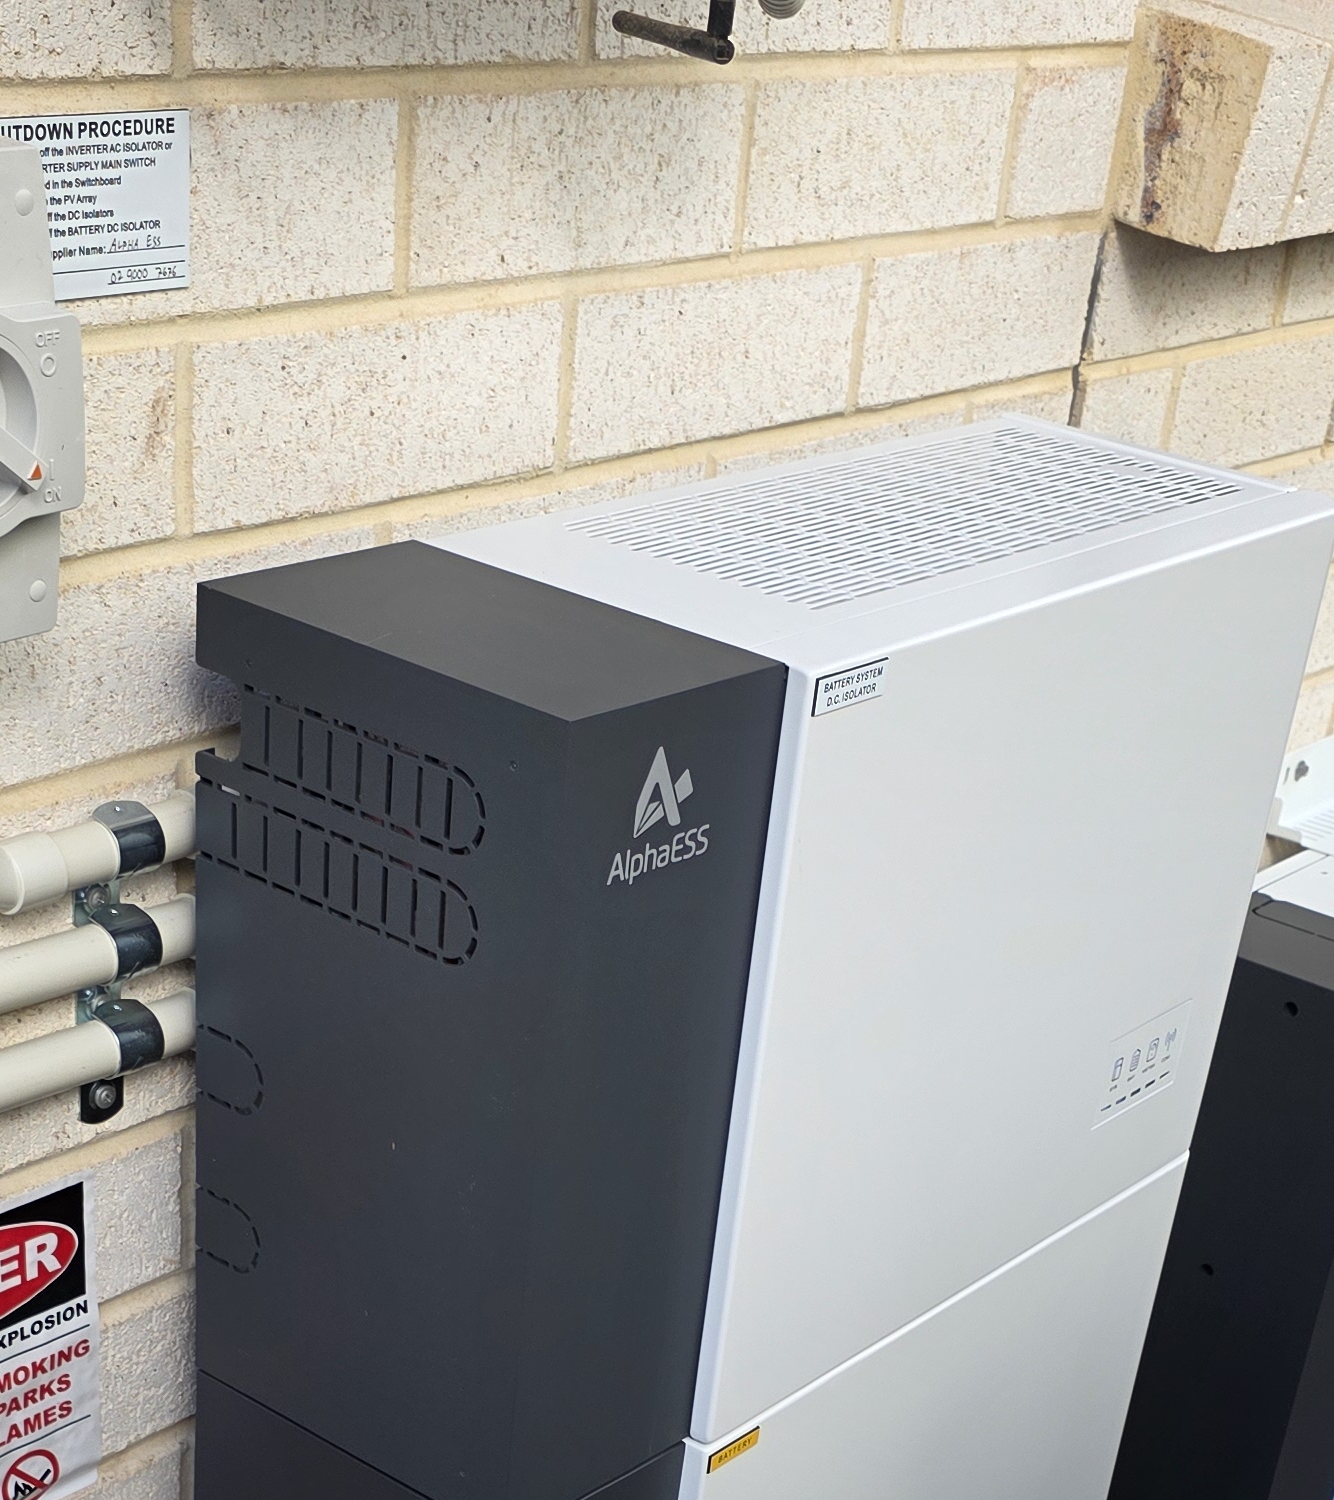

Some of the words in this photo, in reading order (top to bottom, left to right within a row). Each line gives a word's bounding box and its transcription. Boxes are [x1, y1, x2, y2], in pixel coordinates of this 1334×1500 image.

[78, 117, 175, 139] PROCEDURE
[51, 147, 64, 157] the
[66, 144, 108, 156] INVERTER
[109, 142, 122, 154] AC
[123, 141, 164, 153] ISOLATOR
[164, 142, 173, 150] or
[42, 162, 65, 173] RTER
[67, 160, 100, 172] SUPPLY
[101, 159, 122, 170] MAIN
[123, 157, 156, 168] SWITCH
[61, 179, 73, 188] the
[75, 175, 122, 188] Switchboard
[50, 196, 62, 206] the
[63, 194, 75, 205] PV
[76, 193, 97, 206] Array
[54, 211, 66, 221] the
[68, 210, 80, 220] DC
[54, 228, 66, 238] the
[68, 224, 105, 236] BATTERY
[107, 222, 119, 233] DC
[121, 219, 161, 232] ISOLATOR
[51, 247, 76, 261] pplier
[79, 246, 107, 257] Name:
[35, 329, 61, 348] OFF
[43, 485, 62, 503] ON
[824, 674, 856, 693] BATTERY
[856, 666, 883, 684] SYSTEM
[841, 683, 876, 702] ISOLATOR
[606, 824, 710, 885] AlphaESS
[717, 1437, 752, 1463] BATTERY
